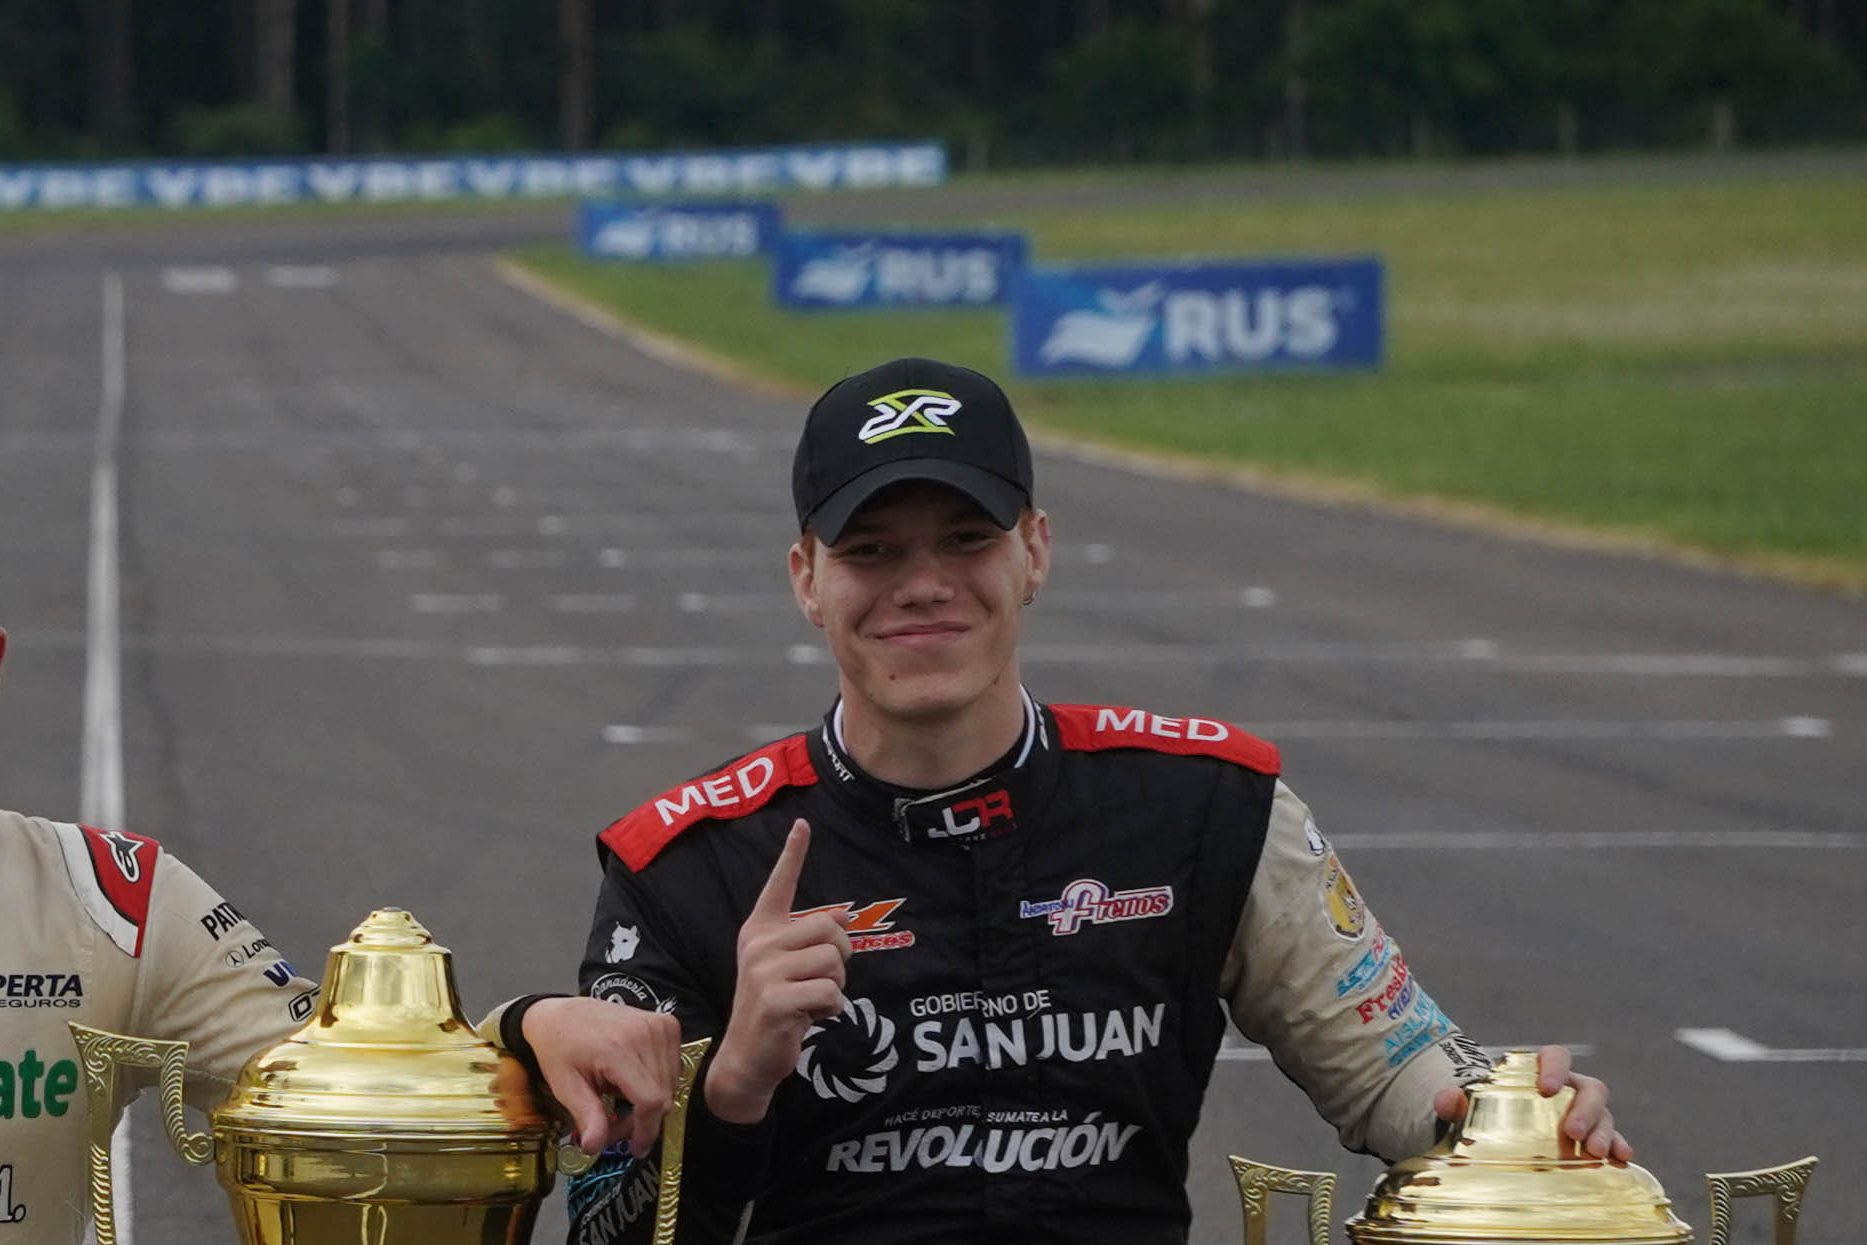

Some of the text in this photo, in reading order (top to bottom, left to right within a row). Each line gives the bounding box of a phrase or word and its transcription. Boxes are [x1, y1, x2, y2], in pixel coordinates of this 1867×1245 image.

[876, 248, 1000, 298] RUS
[1166, 286, 1336, 360] RUS
[1095, 708, 1229, 743] MED
[654, 756, 774, 826] MED
[909, 989, 1053, 1018] GOBIERNO DE
[913, 1002, 1166, 1073] SAN JUAN
[826, 1111, 1142, 1174] REVOLUCIÓN
